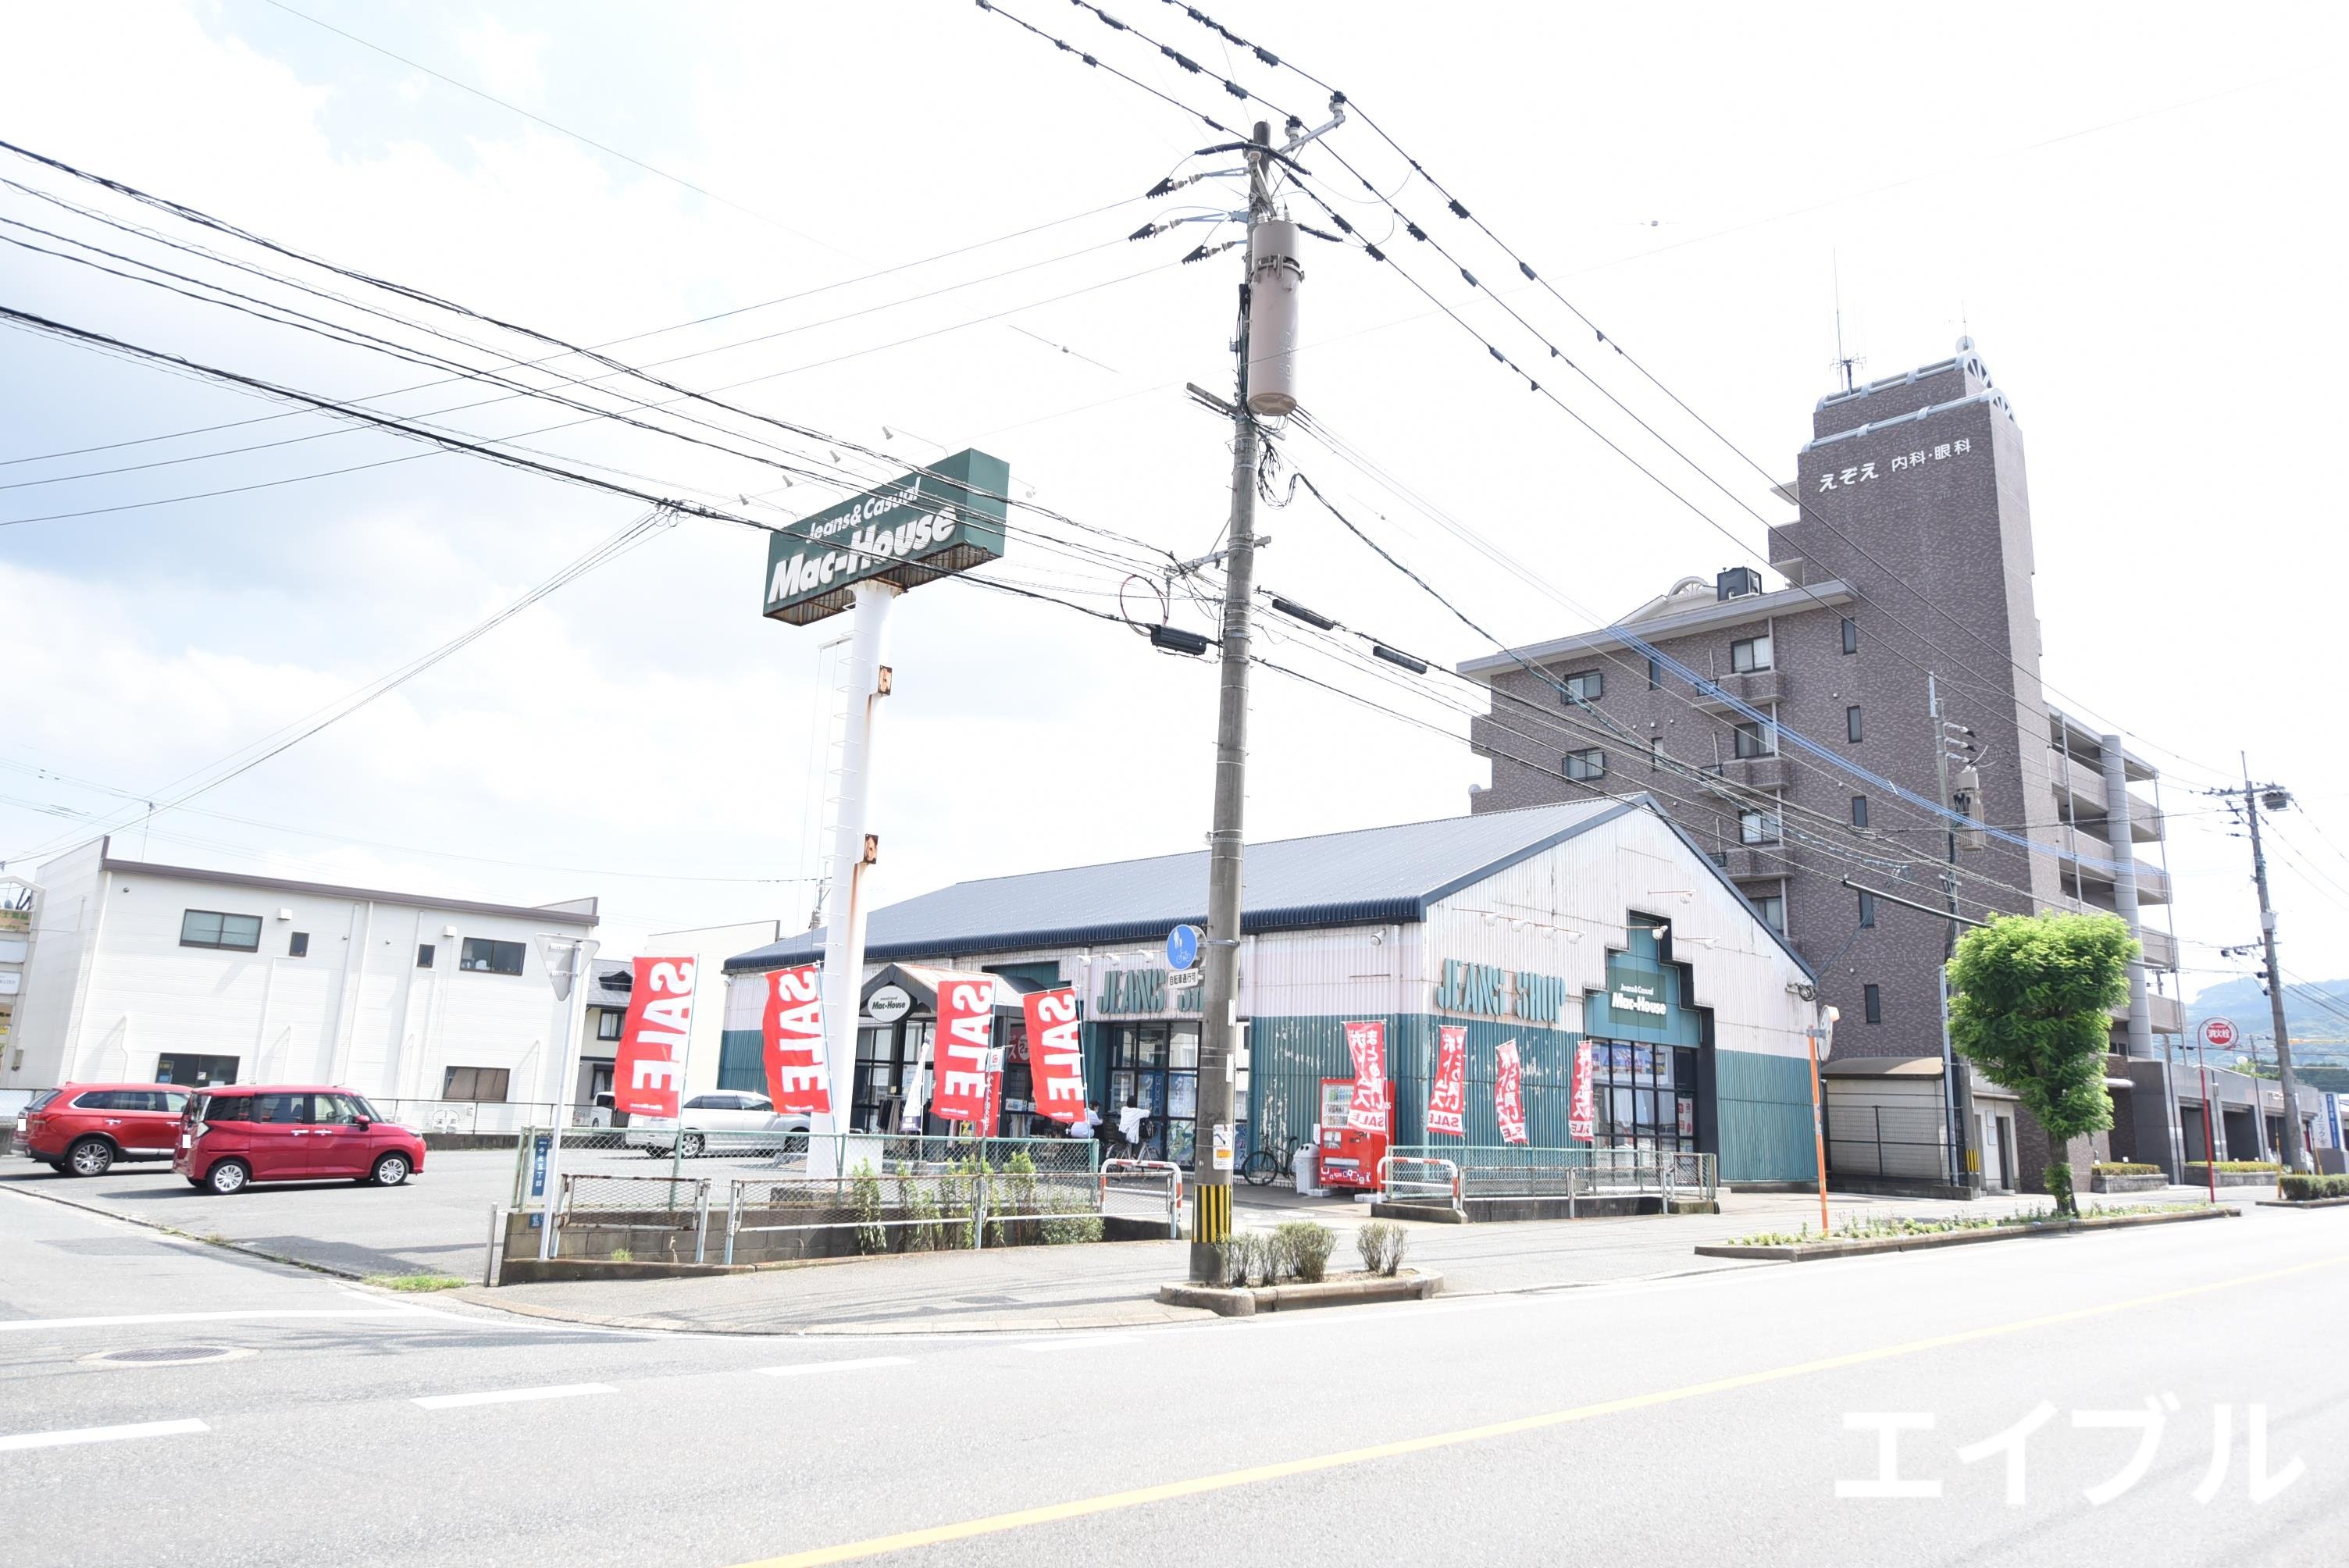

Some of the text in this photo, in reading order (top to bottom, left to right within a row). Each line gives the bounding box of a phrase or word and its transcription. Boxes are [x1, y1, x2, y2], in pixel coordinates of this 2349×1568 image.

[1819, 437, 1973, 493] えぞえ 内科・眼科
[767, 506, 958, 605] Mac-House
[1096, 968, 1166, 1014] JEANS
[1169, 971, 1197, 985] 自転車通行可
[1437, 957, 1567, 1025] JEANS SHOP
[872, 1000, 906, 1010] Mac-House
[1611, 992, 1666, 1015] Mac-House
[2208, 1028, 2230, 1039] 消火栓
